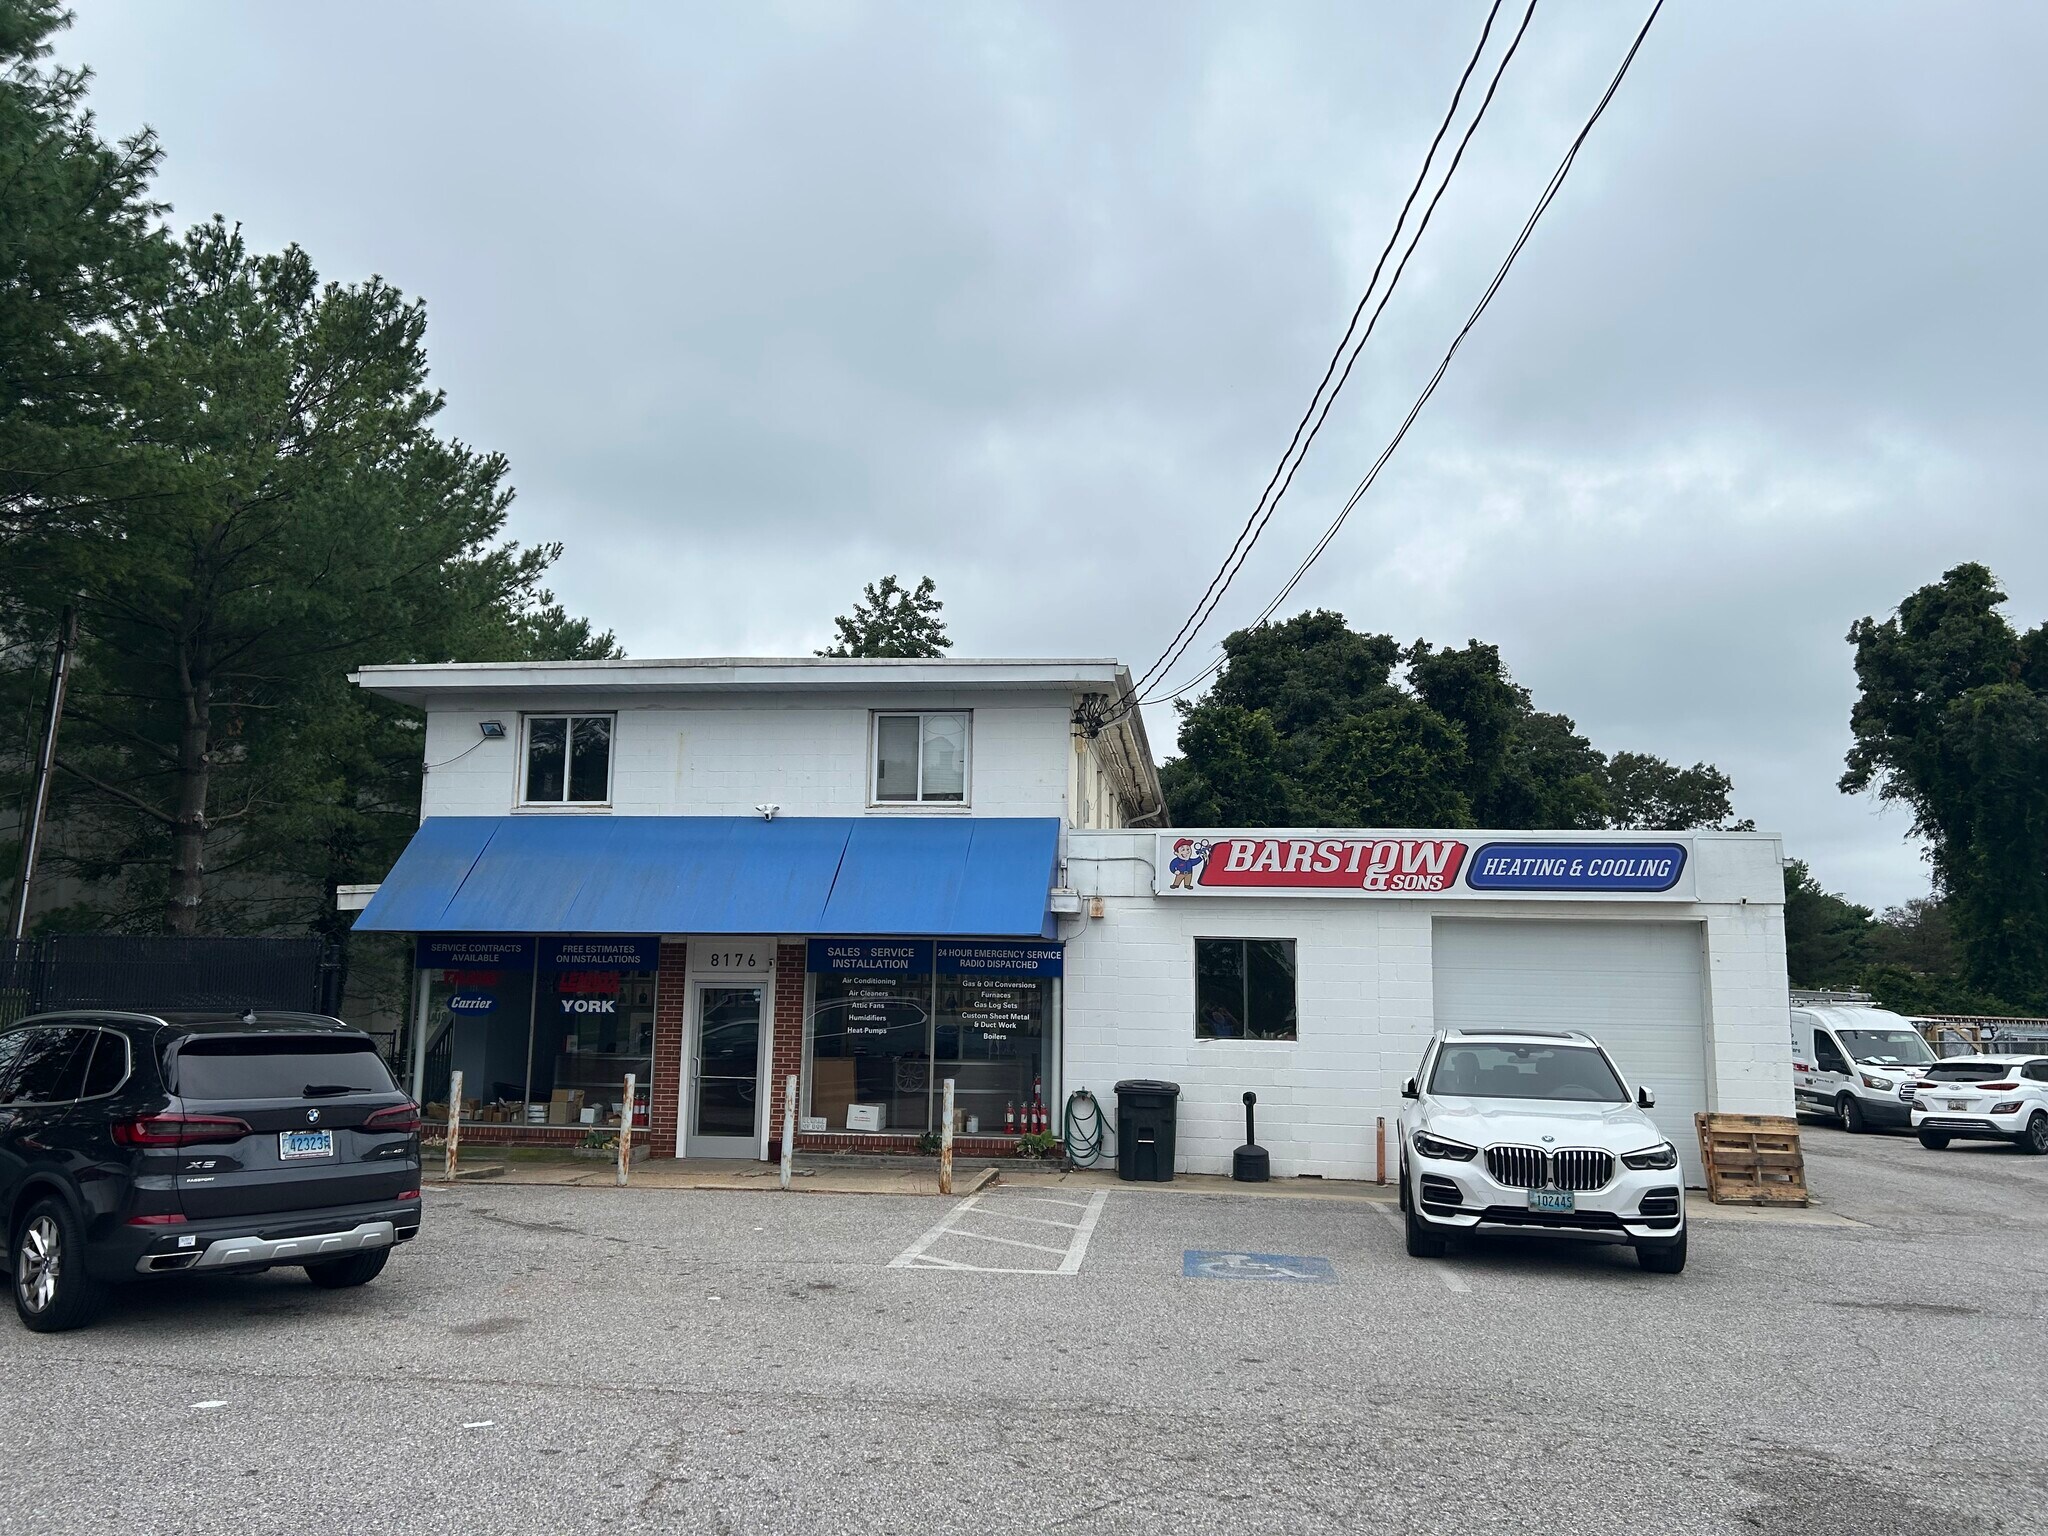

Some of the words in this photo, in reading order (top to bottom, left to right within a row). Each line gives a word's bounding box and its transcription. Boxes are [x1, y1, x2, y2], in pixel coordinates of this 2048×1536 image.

[1223, 840, 1456, 874] BARSTOW
[1482, 858, 1567, 877] HEATING
[1569, 858, 1584, 877] &
[1587, 859, 1672, 877] COOLING
[1363, 863, 1389, 890] &
[1390, 874, 1444, 890] SONS
[431, 943, 467, 952] SERVICE
[468, 944, 522, 953] CONTRACTS
[562, 945, 584, 953] FREE
[585, 945, 635, 954] ESTIMATES
[827, 947, 861, 957] SALES
[870, 947, 915, 957] SERVICE
[451, 953, 500, 962] AVAILABLE
[556, 954, 570, 963] ON
[571, 955, 641, 963] INSTALLATIONS
[938, 948, 947, 957] 24
[948, 949, 973, 957] HOUR
[974, 949, 1025, 959] EMERGENCY
[1026, 950, 1062, 960] SERVICE
[711, 953, 756, 967] 8176
[832, 959, 909, 969] INSTALLATION
[960, 959, 985, 968] RADIO
[987, 960, 1038, 969] DISPATCHED
[853, 977, 896, 986] Conditioning
[983, 980, 994, 988] Oil
[994, 981, 1036, 989] Conversions
[848, 989, 858, 997] Air
[860, 989, 889, 997] Cleaners
[981, 991, 1011, 999] Furnaces
[451, 996, 492, 1009] Carrier
[561, 1000, 615, 1013] YORK
[988, 1001, 1001, 1010] Log
[989, 1012, 1009, 1020] Sheet
[864, 1027, 887, 1035] Pumps
[290, 1137, 323, 1152] 42323
[185, 1160, 217, 1169] X5
